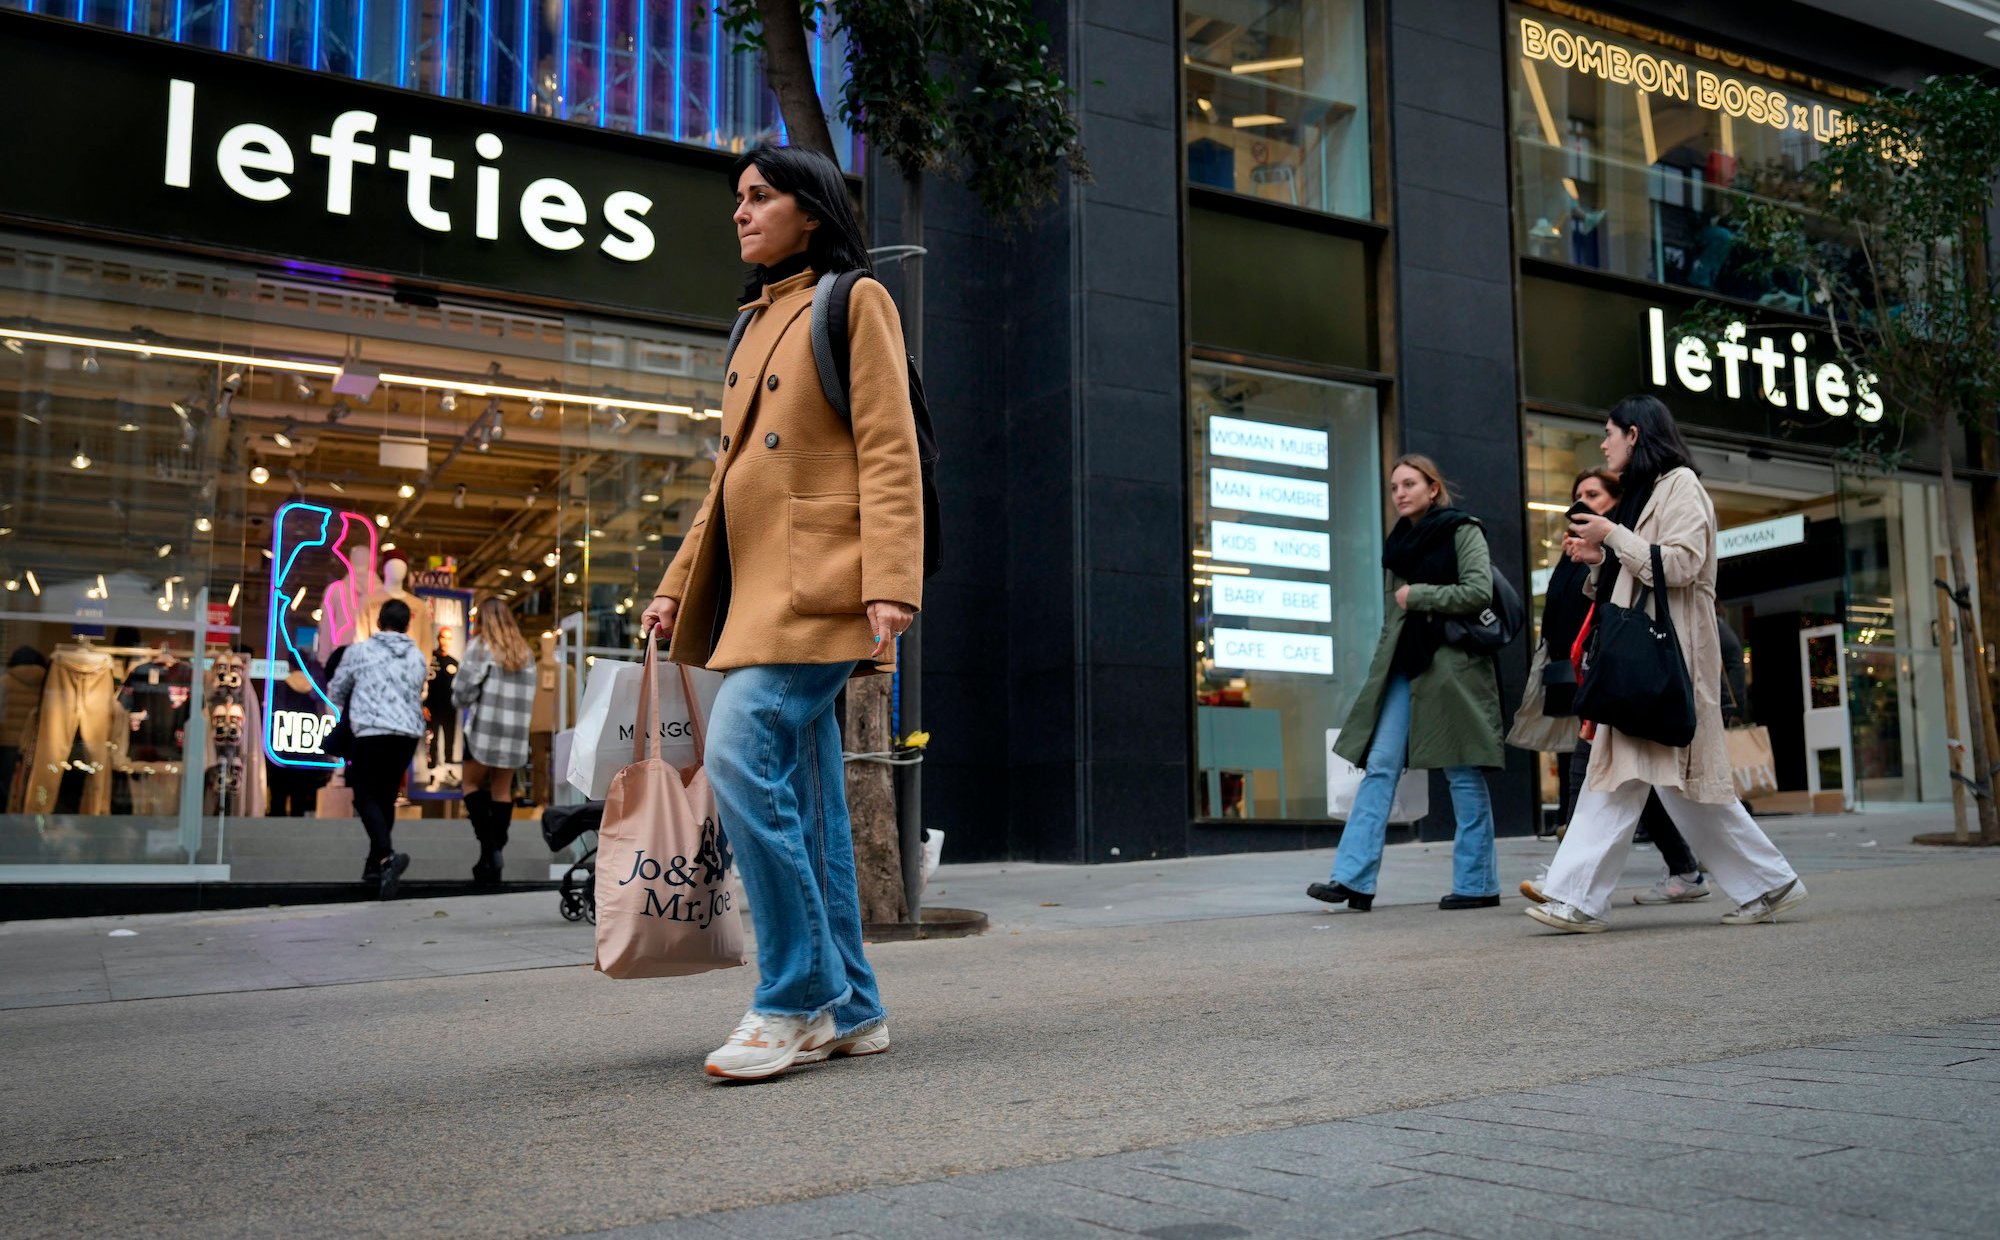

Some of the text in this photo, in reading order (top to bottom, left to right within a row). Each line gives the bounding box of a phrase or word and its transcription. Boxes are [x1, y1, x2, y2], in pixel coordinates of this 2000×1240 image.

[1520, 18, 1689, 101] BOMBON
[1696, 70, 1789, 130] BOSS
[163, 78, 656, 262] lefties
[1649, 307, 1884, 423] lefties
[1211, 429, 1274, 450] WOMAN
[1215, 480, 1325, 508] MAN HOMBRE
[1221, 534, 1257, 552] KIDS
[1723, 527, 1776, 549] WOMAN
[1224, 587, 1265, 604] BABY
[1225, 640, 1265, 659] CAFE
